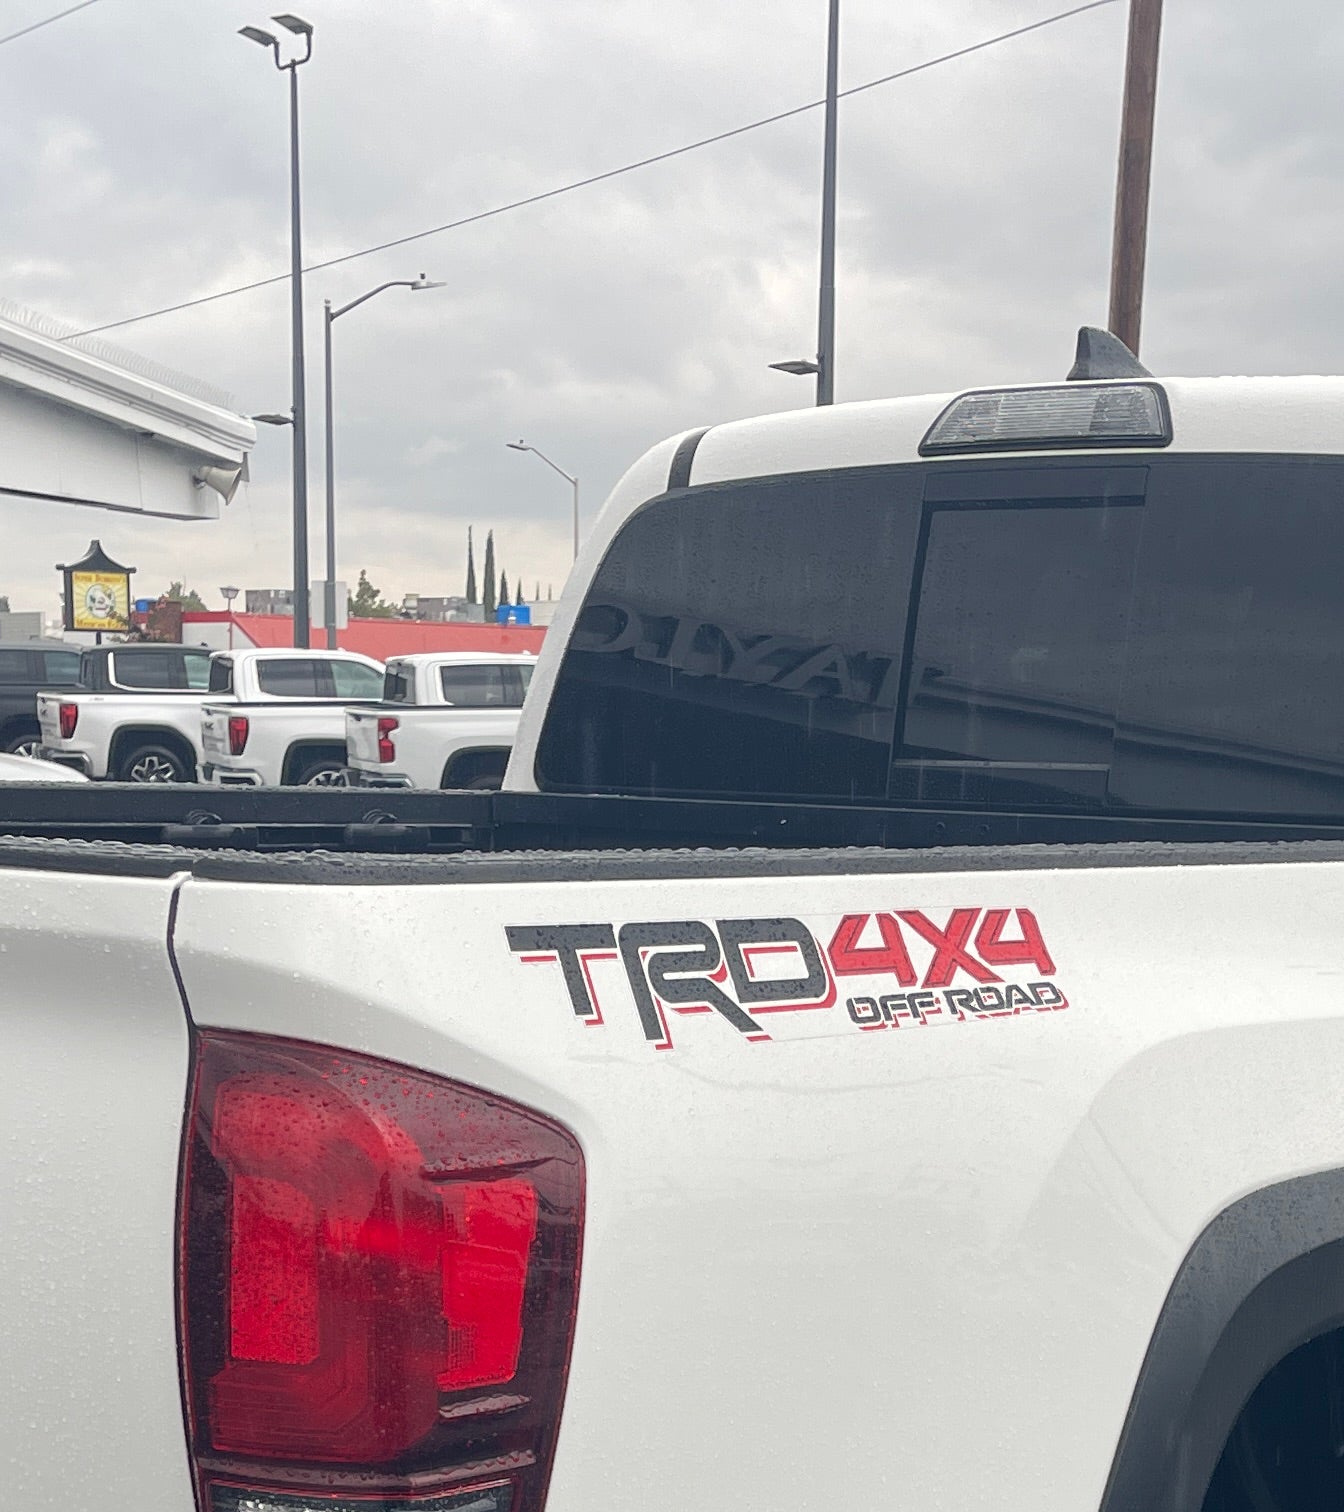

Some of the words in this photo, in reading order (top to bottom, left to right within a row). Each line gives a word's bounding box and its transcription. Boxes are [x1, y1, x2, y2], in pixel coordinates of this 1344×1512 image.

[505, 917, 837, 1050] TRD
[831, 907, 1057, 988] 4X4
[846, 988, 942, 1031] OFF
[944, 981, 1070, 1022] ROAD
